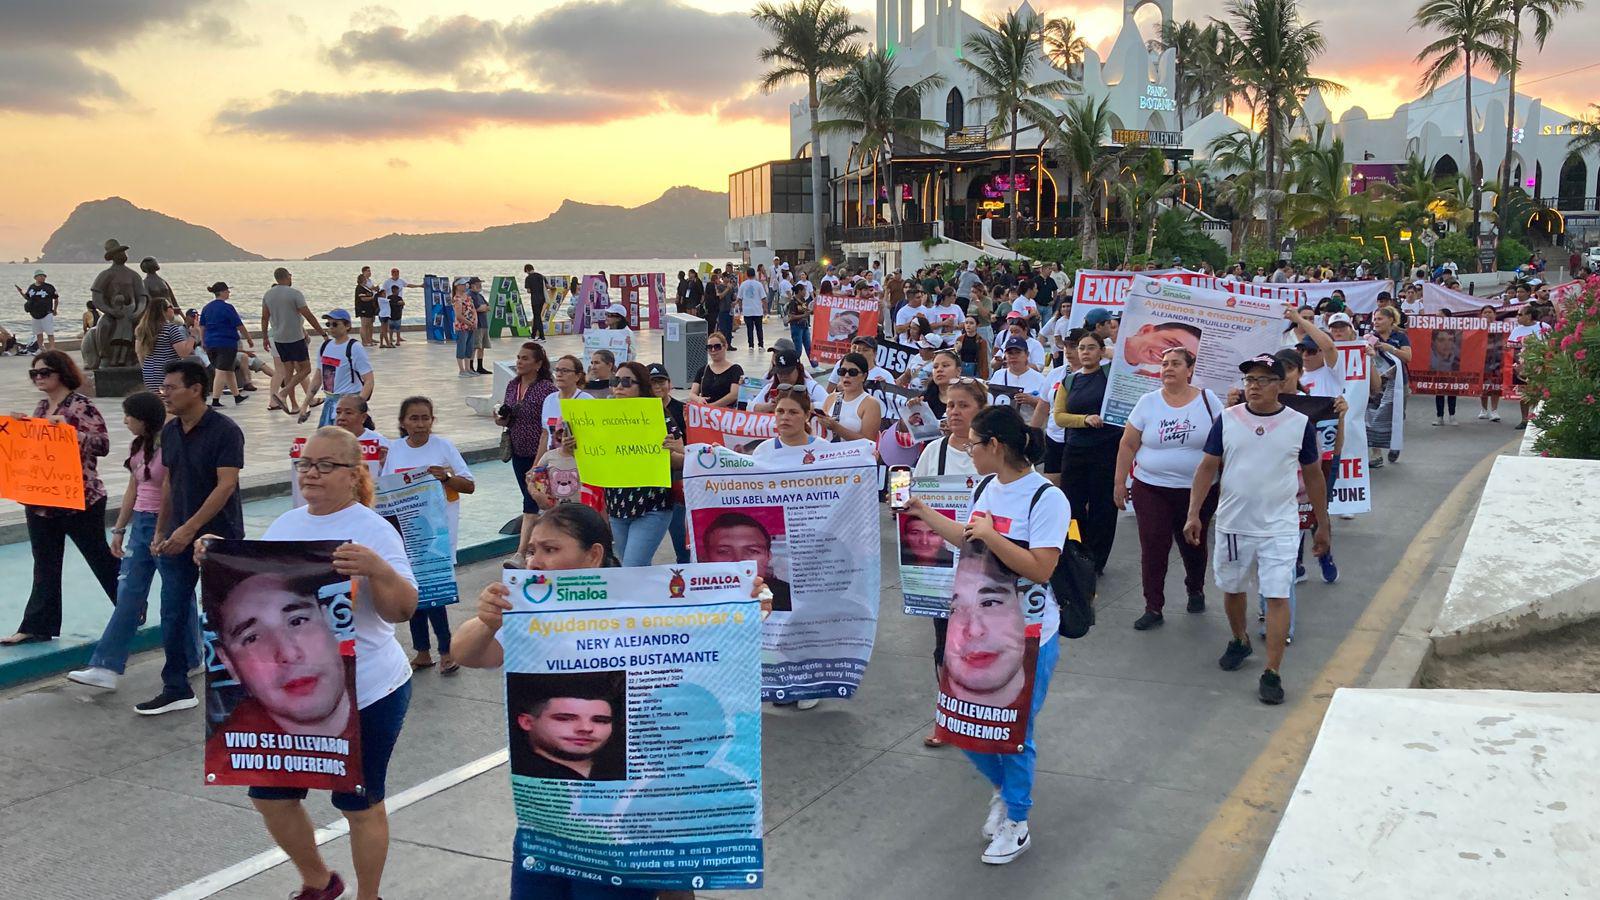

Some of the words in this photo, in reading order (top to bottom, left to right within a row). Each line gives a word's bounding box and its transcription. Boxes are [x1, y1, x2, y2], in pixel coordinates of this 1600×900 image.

[1543, 125, 1600, 135] SPEC
[1162, 290, 1192, 300] Sinaloa
[816, 295, 879, 312] DESAPARECIDO
[1151, 310, 1194, 322] ALEJANDRO
[1196, 317, 1230, 329] TRUJILLO
[1231, 323, 1252, 332] CRUZ
[1206, 310, 1261, 326] encontrar
[1409, 316, 1487, 329] DESAPARECIDO
[1450, 382, 1469, 390] 1930
[602, 409, 651, 426] encontrarte
[584, 445, 606, 456] LUIS
[615, 445, 661, 456] ARMANDO
[819, 448, 860, 460] SINALOA
[720, 456, 754, 468] Sinaloa
[705, 479, 764, 494] Ayúdanos
[768, 480, 776, 489] a
[780, 474, 848, 488] encontrar
[853, 475, 861, 483] a
[721, 495, 740, 505] LUIS
[742, 494, 764, 504] ABEL
[766, 493, 803, 504] AMAYA
[805, 491, 840, 502] AVITIA
[690, 576, 741, 586] SINALOA
[557, 587, 608, 601] Sinaloa
[529, 616, 620, 637] Ayúdanos
[625, 617, 636, 629] a
[642, 610, 729, 627] encontrar
[576, 637, 610, 650] NERY
[614, 633, 690, 649] ALEJANDRO
[546, 656, 626, 670] VILLALOBOS
[629, 650, 719, 667] BUSTAMANTE
[834, 660, 851, 668] esta
[825, 671, 843, 680] muy
[957, 700, 1018, 723] LLEVARON
[947, 716, 1010, 741] QUEREMOS
[225, 732, 258, 748] VIVO
[260, 732, 276, 749] SE
[277, 734, 292, 750] LO
[294, 734, 349, 756] LLEVARON
[231, 753, 264, 770] VIVO
[266, 754, 281, 771] LO
[283, 755, 346, 777] QUEREMOS
[629, 847, 675, 857] referente
[690, 846, 711, 855] esta
[716, 843, 758, 858] persona.
[550, 864, 565, 873] 669
[566, 867, 581, 877] 327
[616, 859, 627, 869] Tu
[629, 857, 660, 870] ayuda
[663, 859, 675, 869] es
[678, 858, 700, 871] muy
[703, 855, 759, 870] importante.
